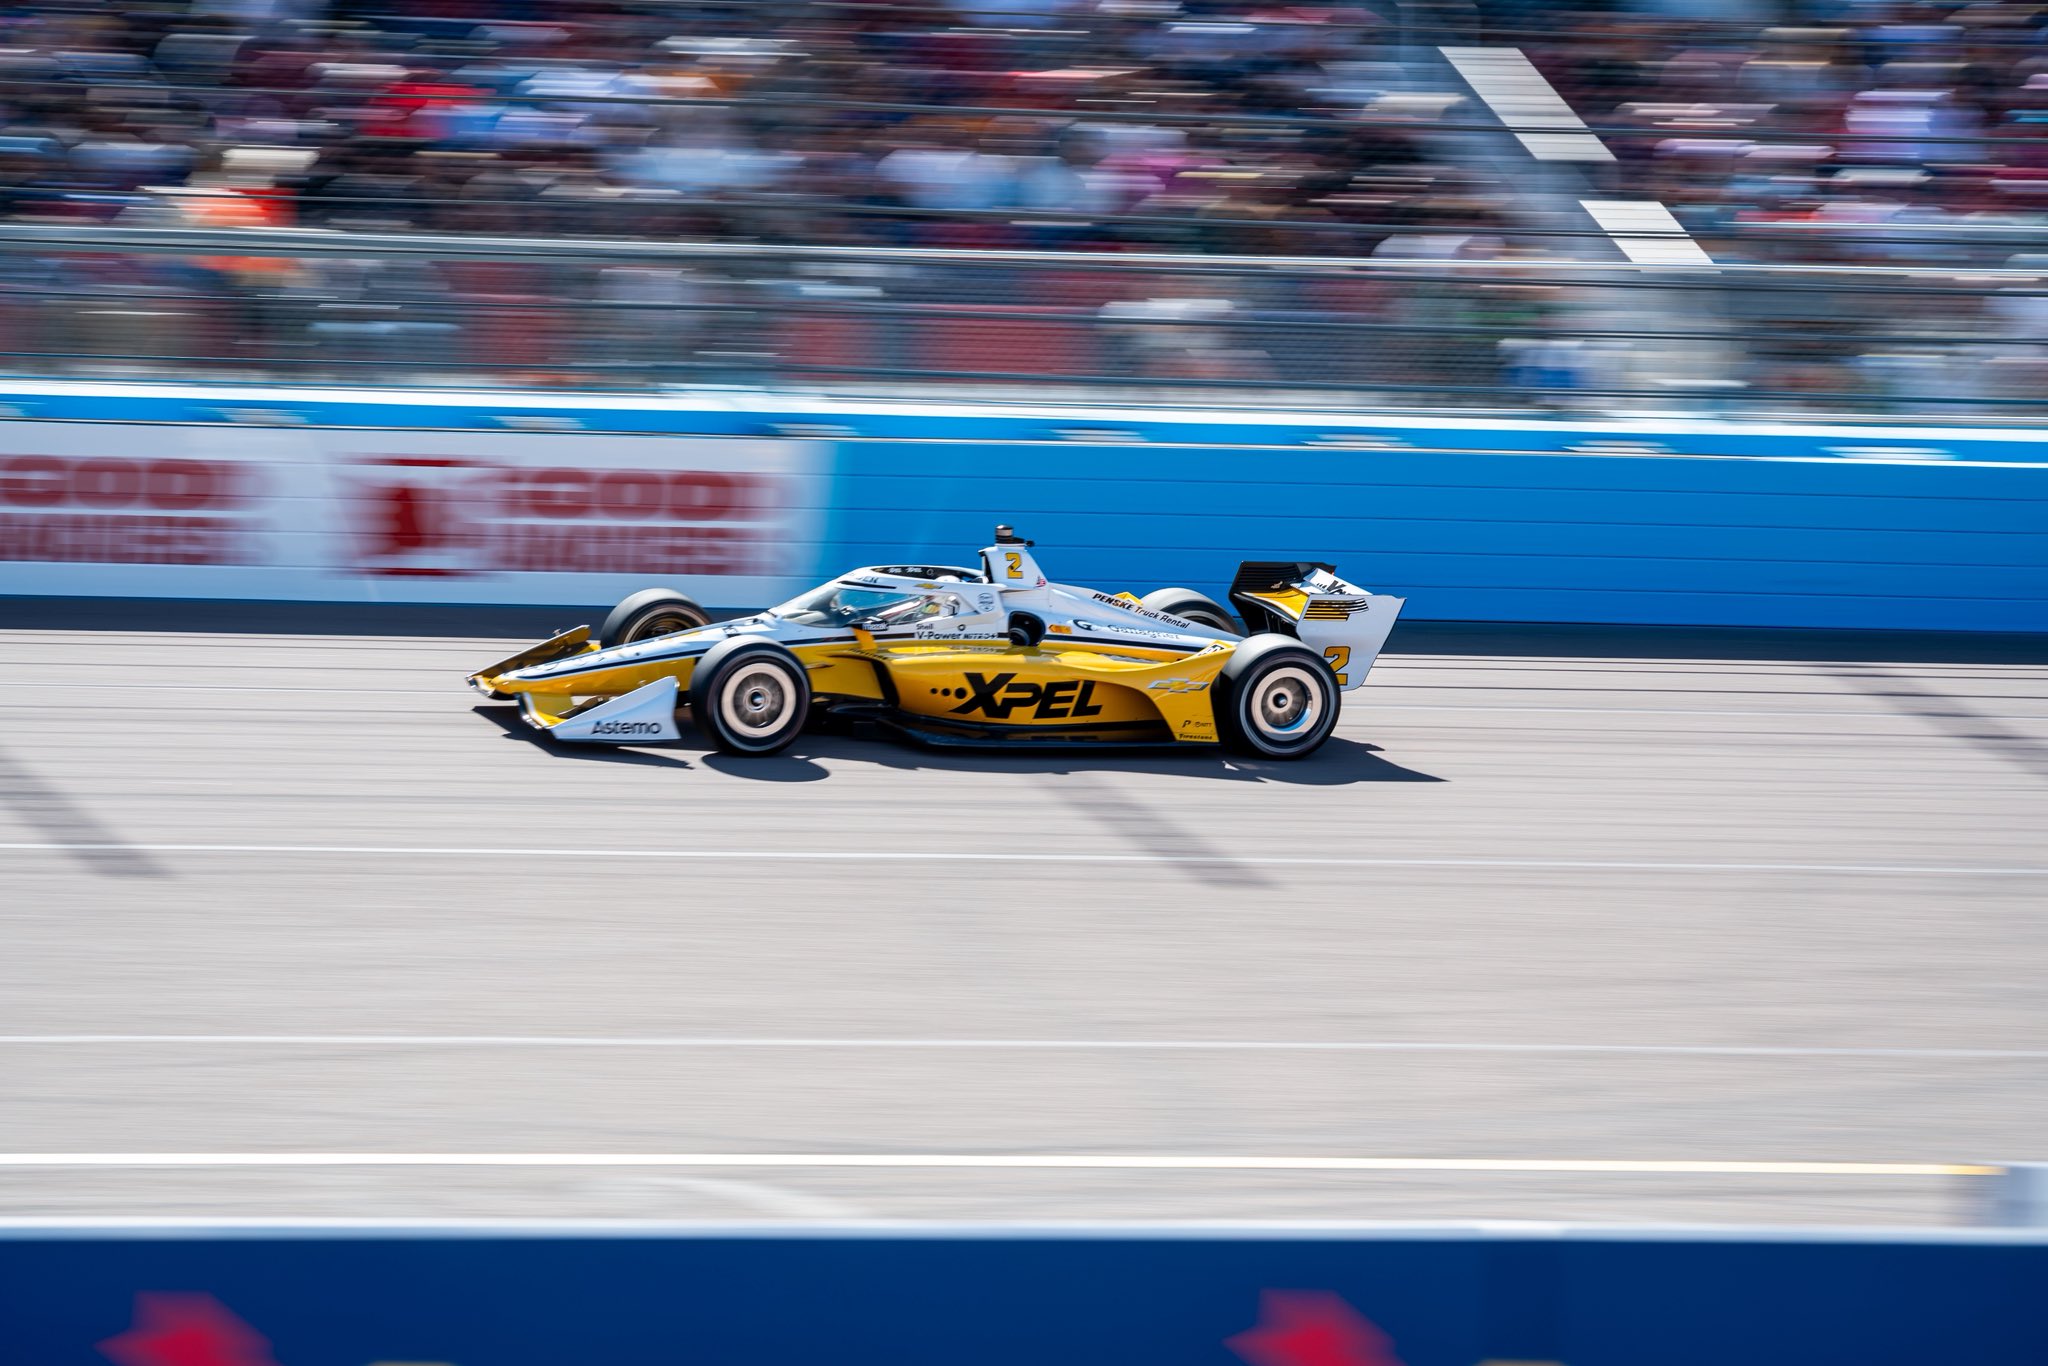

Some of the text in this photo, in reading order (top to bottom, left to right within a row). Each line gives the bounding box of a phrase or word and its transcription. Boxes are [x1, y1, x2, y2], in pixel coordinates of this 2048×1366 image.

[1005, 552, 1024, 579] 2
[1092, 593, 1191, 629] PENSKE Truck Rental
[917, 631, 962, 640] V-Power
[1323, 646, 1351, 686] 2
[948, 672, 1103, 719] XPEL
[591, 720, 662, 735] Astemo
